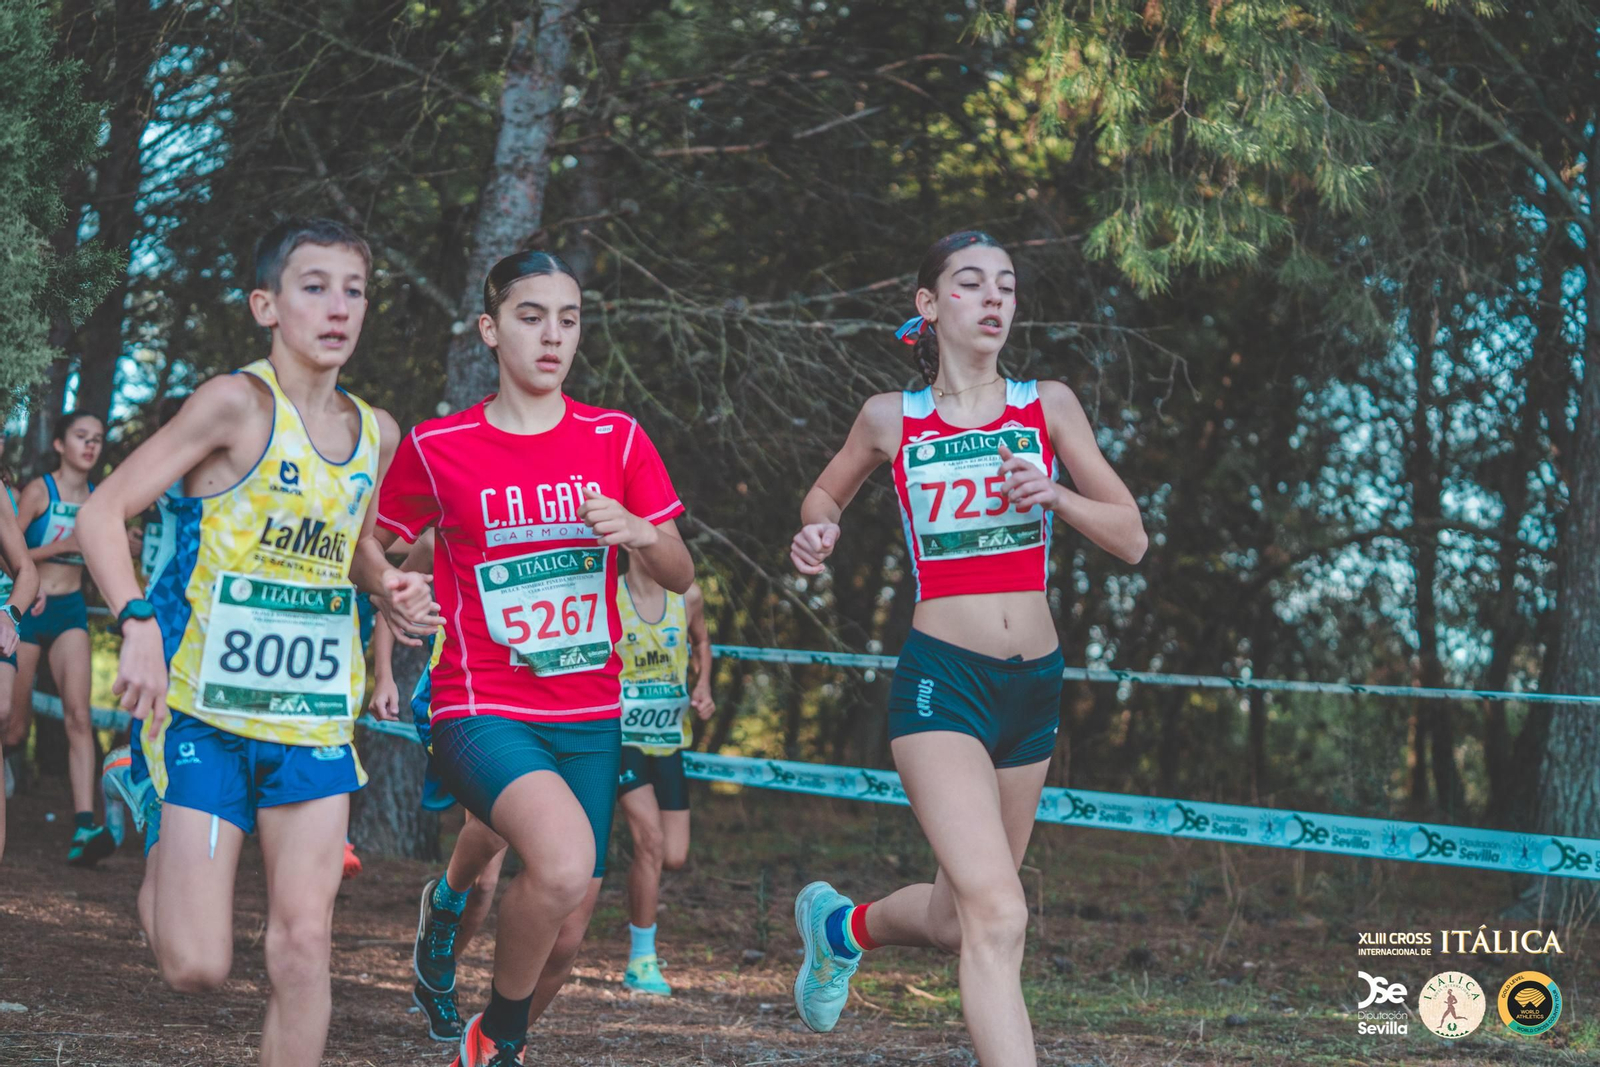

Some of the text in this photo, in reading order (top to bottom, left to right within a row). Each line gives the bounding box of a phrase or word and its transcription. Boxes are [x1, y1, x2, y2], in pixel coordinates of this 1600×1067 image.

[945, 435, 1008, 454] ITÁLICA
[480, 485, 533, 529] C.A.
[493, 526, 597, 542] CARMON
[516, 554, 578, 577] ITÁLICA
[261, 584, 324, 607] ITÁLICA
[502, 593, 598, 644] 5267
[219, 629, 340, 681] 8005
[624, 707, 682, 728] 8001
[1211, 822, 1247, 837] Sevilla
[1331, 834, 1370, 849] Sevilla
[1459, 846, 1500, 863] Sevilla
